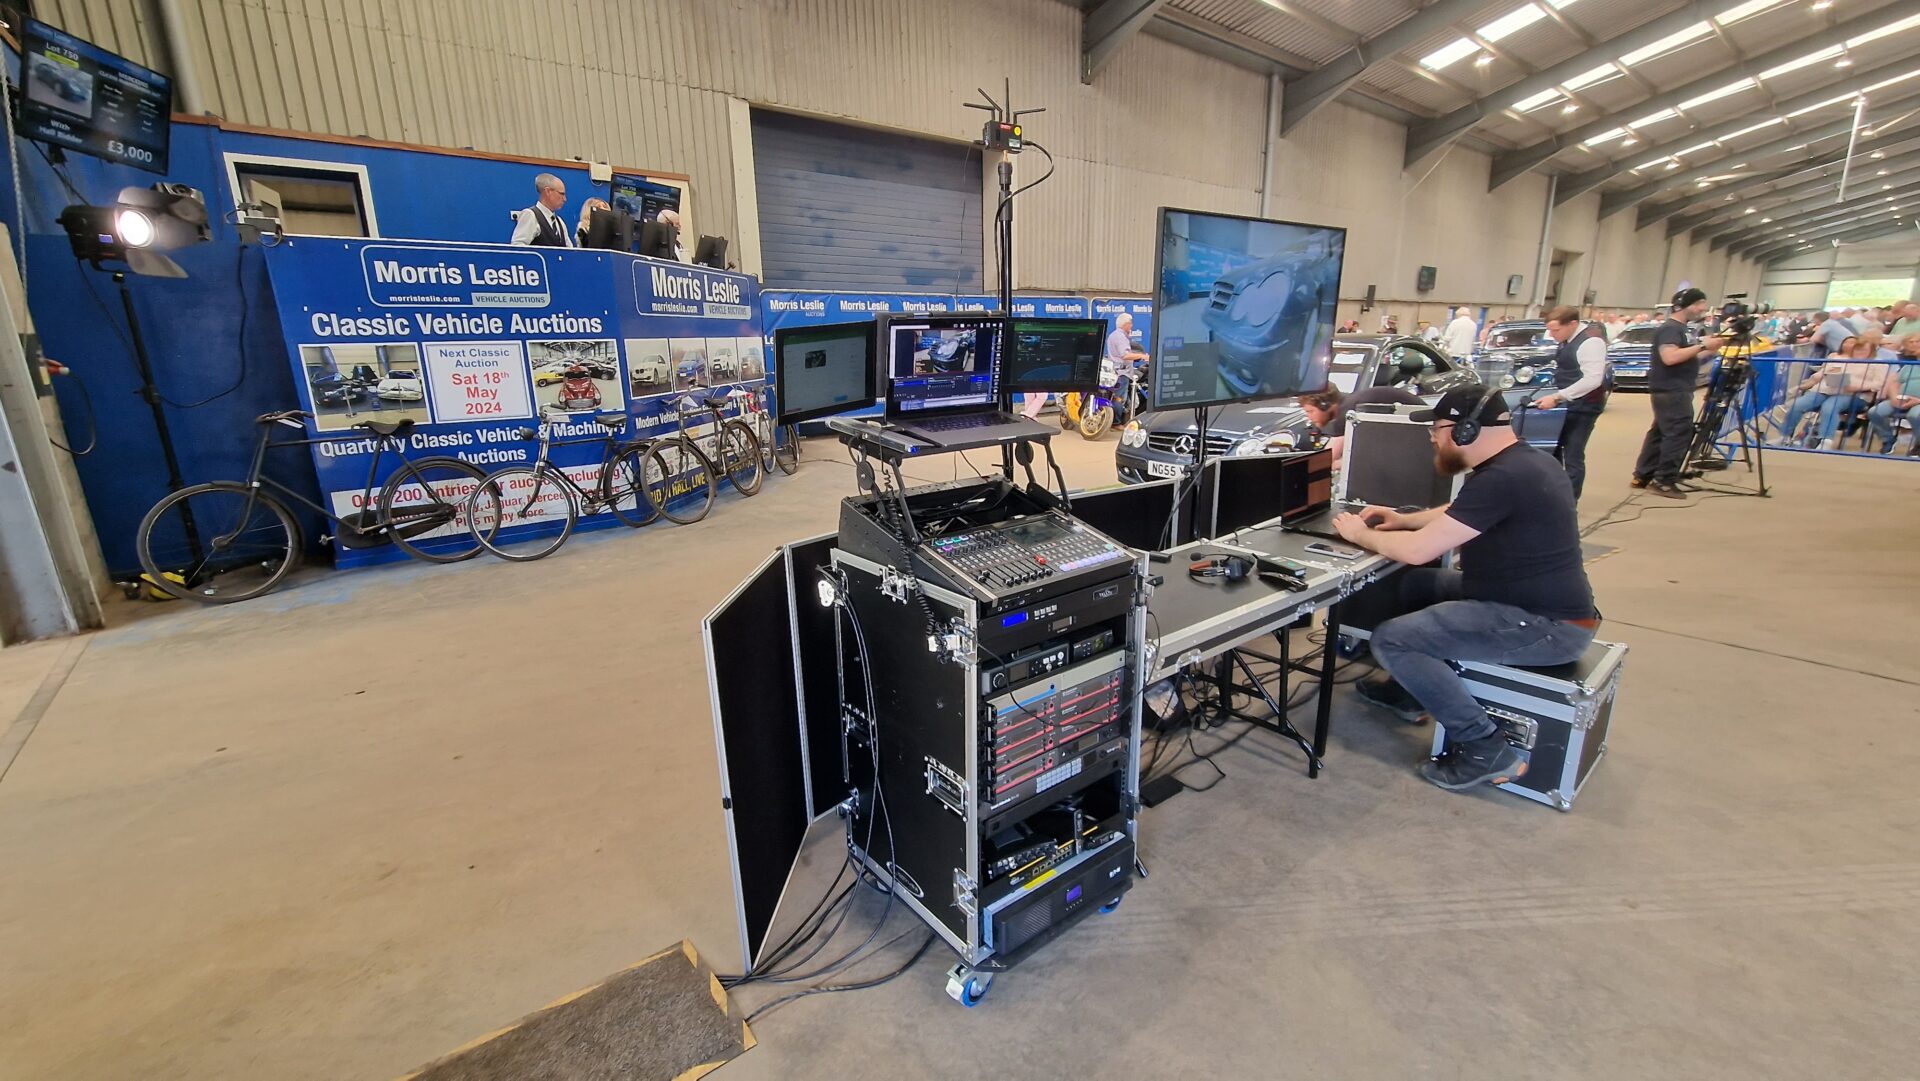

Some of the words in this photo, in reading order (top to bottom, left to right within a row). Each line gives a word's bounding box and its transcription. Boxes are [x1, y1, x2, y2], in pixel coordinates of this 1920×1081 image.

[108, 140, 153, 163] £3,000
[373, 260, 463, 285] Morris
[469, 263, 541, 287] Leslie
[650, 266, 702, 301] Morris
[703, 274, 740, 304] Leslie
[389, 293, 461, 304] morrisleslie.com
[475, 295, 508, 305] VEHICLE
[508, 295, 546, 305] AUCTIONS
[770, 299, 798, 311] Morris
[800, 299, 825, 311] Leslie
[840, 300, 865, 311] Morris
[866, 300, 890, 311] Leslie
[651, 302, 698, 314] morrisleslie.com
[709, 305, 727, 315] VEHICLE
[727, 306, 747, 316] AUCTIONS
[903, 301, 926, 311] Morris
[926, 301, 947, 312] Leslie
[965, 303, 984, 312] Leslie
[1017, 303, 1035, 312] Leslie
[1045, 303, 1064, 312] Morris
[1065, 303, 1082, 312] Leslie
[311, 312, 410, 337] Classic
[415, 312, 503, 336] Vehicle
[510, 312, 603, 335] Auctions
[439, 348, 469, 358] Next
[470, 348, 510, 358] Classic
[455, 358, 499, 368] Auction
[452, 373, 478, 386] Sat
[482, 371, 510, 385] 18th
[466, 386, 498, 400] May
[465, 401, 503, 415] 2024
[636, 415, 660, 430] Modern
[411, 430, 473, 449] Classic
[476, 427, 530, 444] Vehic
[457, 447, 527, 465] Auctions
[1152, 462, 1176, 477] NG55
[692, 472, 706, 489] LIVE
[352, 491, 383, 508] Oe
[394, 488, 423, 503] 200
[455, 516, 481, 528] Pls
[484, 513, 514, 525] mny
